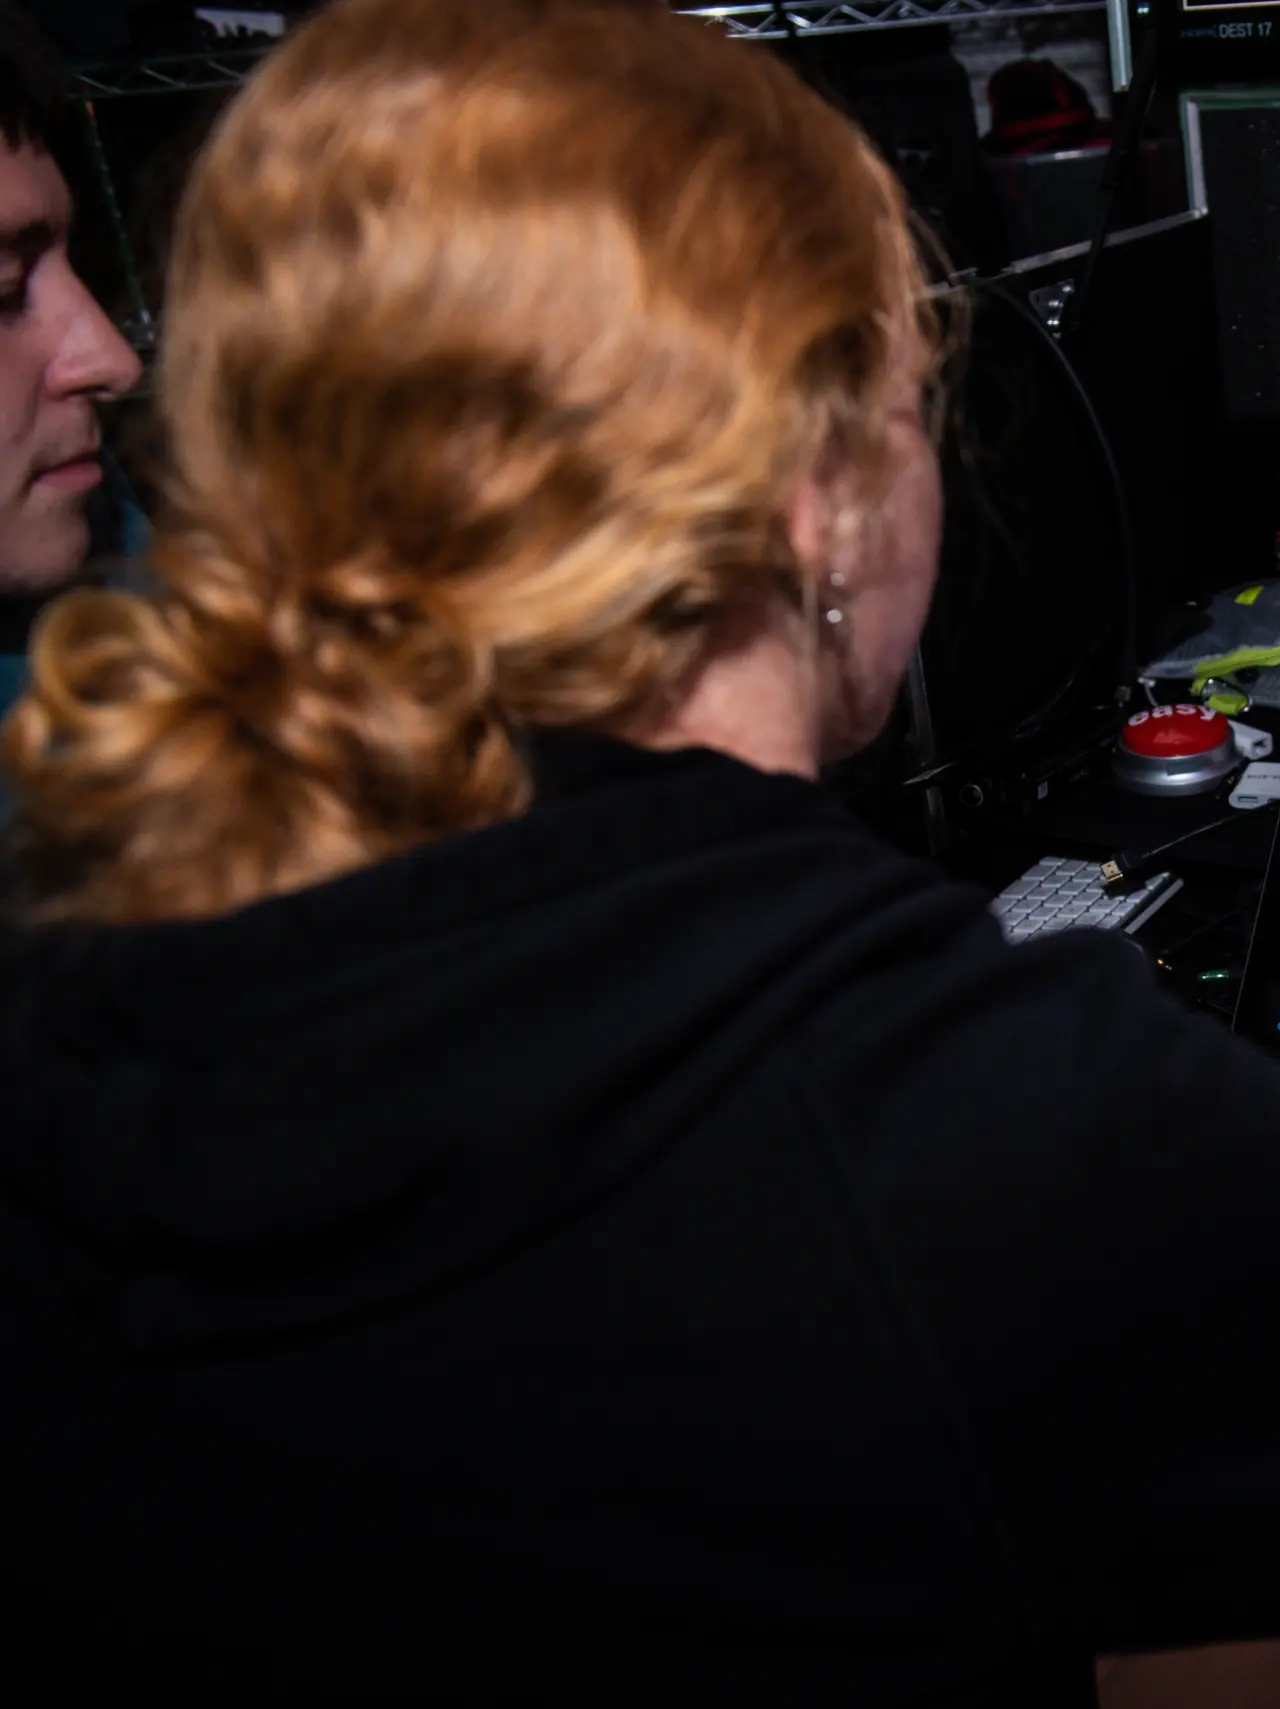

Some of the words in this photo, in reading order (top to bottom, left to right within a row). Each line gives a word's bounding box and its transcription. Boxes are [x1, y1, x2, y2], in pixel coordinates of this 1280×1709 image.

[1219, 22, 1254, 38] DEST
[1258, 21, 1272, 36] 17
[1128, 703, 1217, 726] easy
